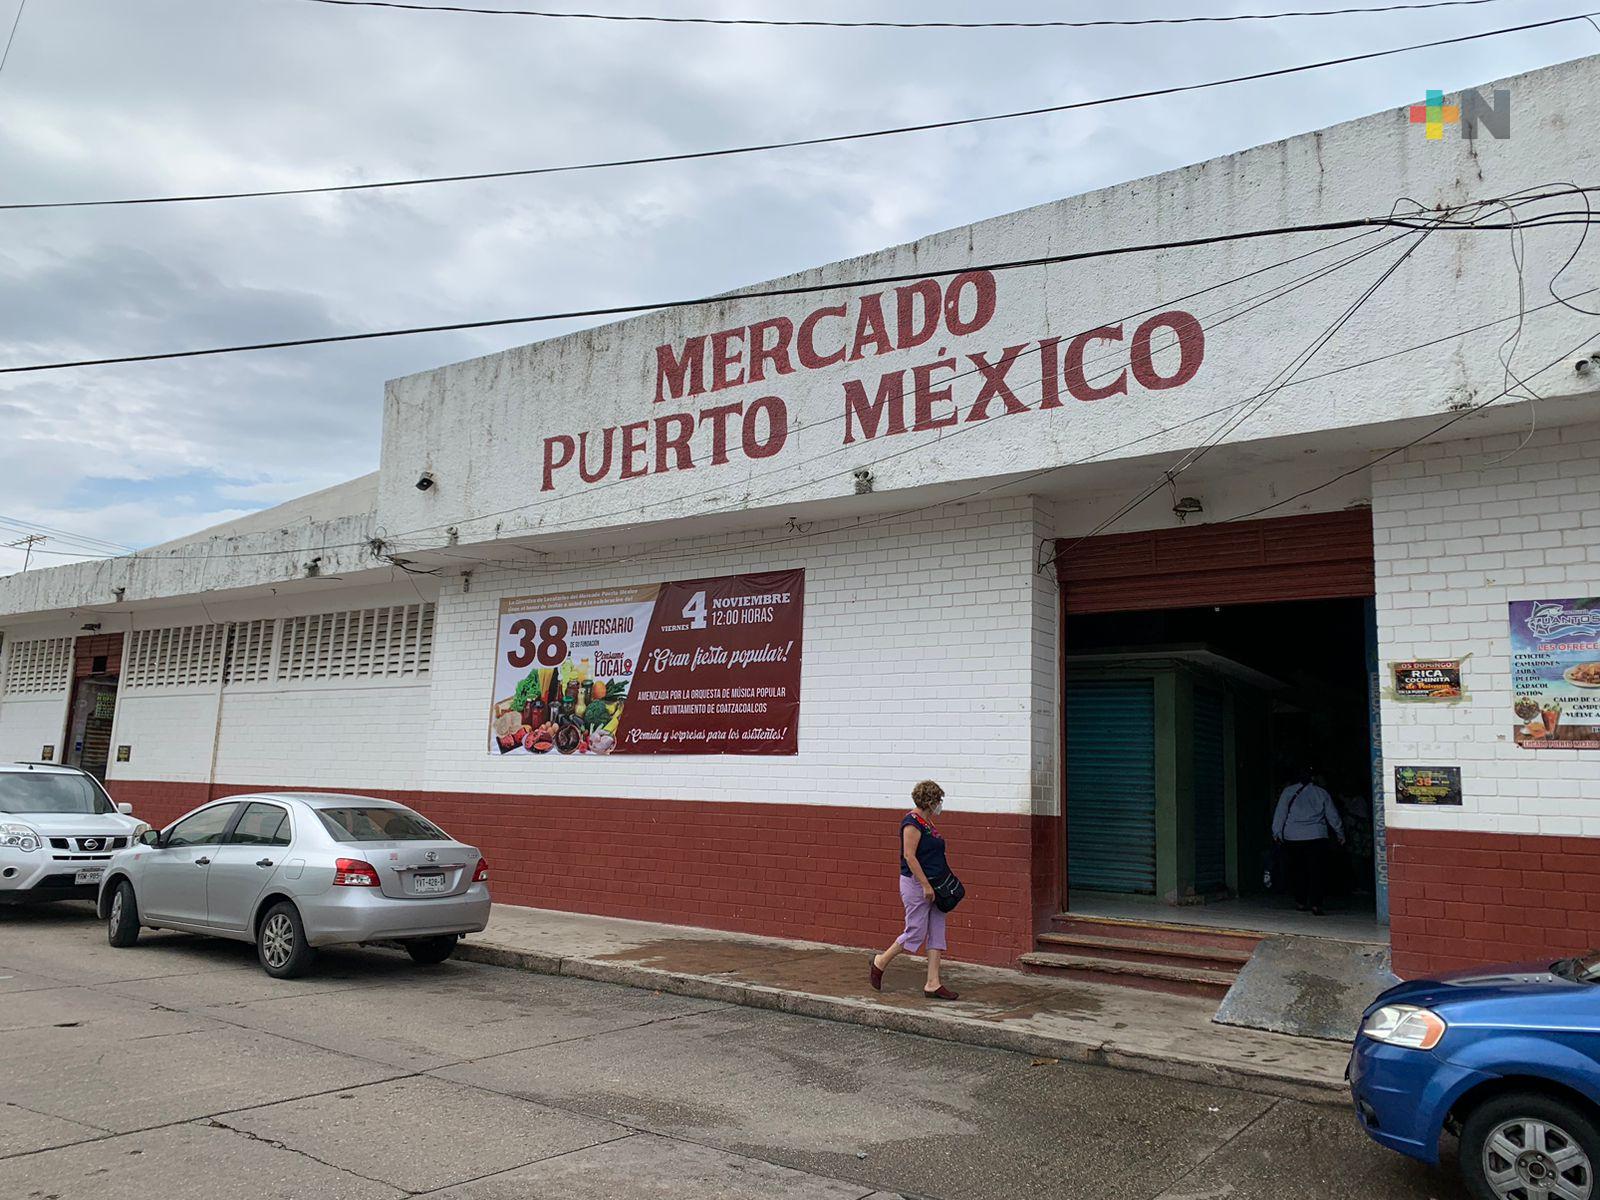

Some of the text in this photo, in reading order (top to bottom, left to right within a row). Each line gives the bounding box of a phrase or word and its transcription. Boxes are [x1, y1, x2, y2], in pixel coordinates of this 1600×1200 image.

[653, 269, 996, 403] MERCADO
[540, 310, 1205, 492] PUERTO MÉXICO
[712, 593, 791, 609] NOVIEMBRE
[661, 591, 708, 632] VIERNES 4
[712, 607, 774, 625] 12:00 HORAS
[507, 616, 634, 668] 38 ANIVERSARIO
[643, 641, 794, 673] ¡Gran fiesta popular!
[595, 660, 626, 678] LOCAL
[1411, 669, 1443, 678] RICA
[670, 690, 682, 700] POR
[683, 690, 690, 700] LA
[691, 689, 720, 699] ORQUESTA
[722, 688, 730, 698] DE
[756, 687, 786, 698] POPULAR
[651, 705, 661, 715] DEL
[663, 704, 705, 715] AYUNTAMIENTO
[707, 704, 715, 714] DE
[663, 732, 670, 743] y
[671, 730, 706, 743] sorpresas
[706, 731, 726, 743] para
[728, 729, 739, 740] los
[742, 727, 788, 740] asistentes!
